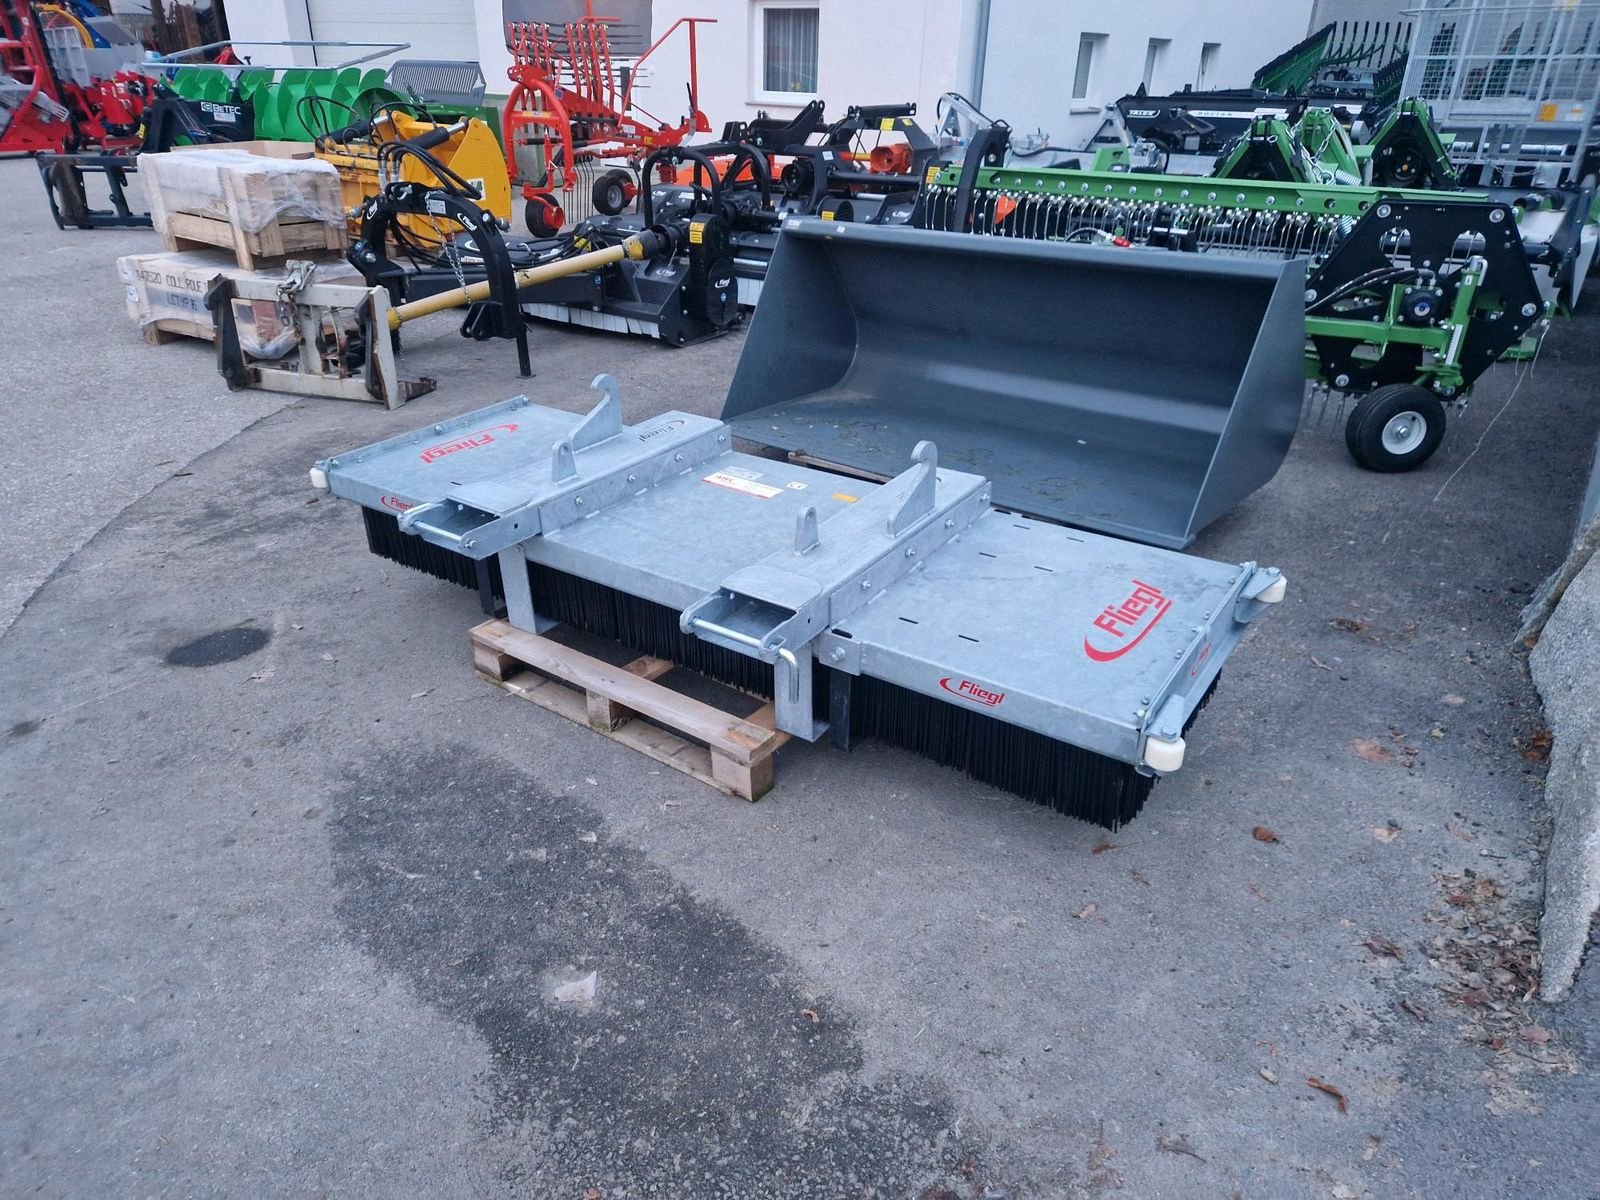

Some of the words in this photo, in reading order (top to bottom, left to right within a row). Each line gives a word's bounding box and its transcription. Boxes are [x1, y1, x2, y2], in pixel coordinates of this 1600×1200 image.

[420, 434, 496, 464] Fliegl
[1092, 578, 1166, 638] Fliegl
[959, 680, 1005, 705] Fliegl
